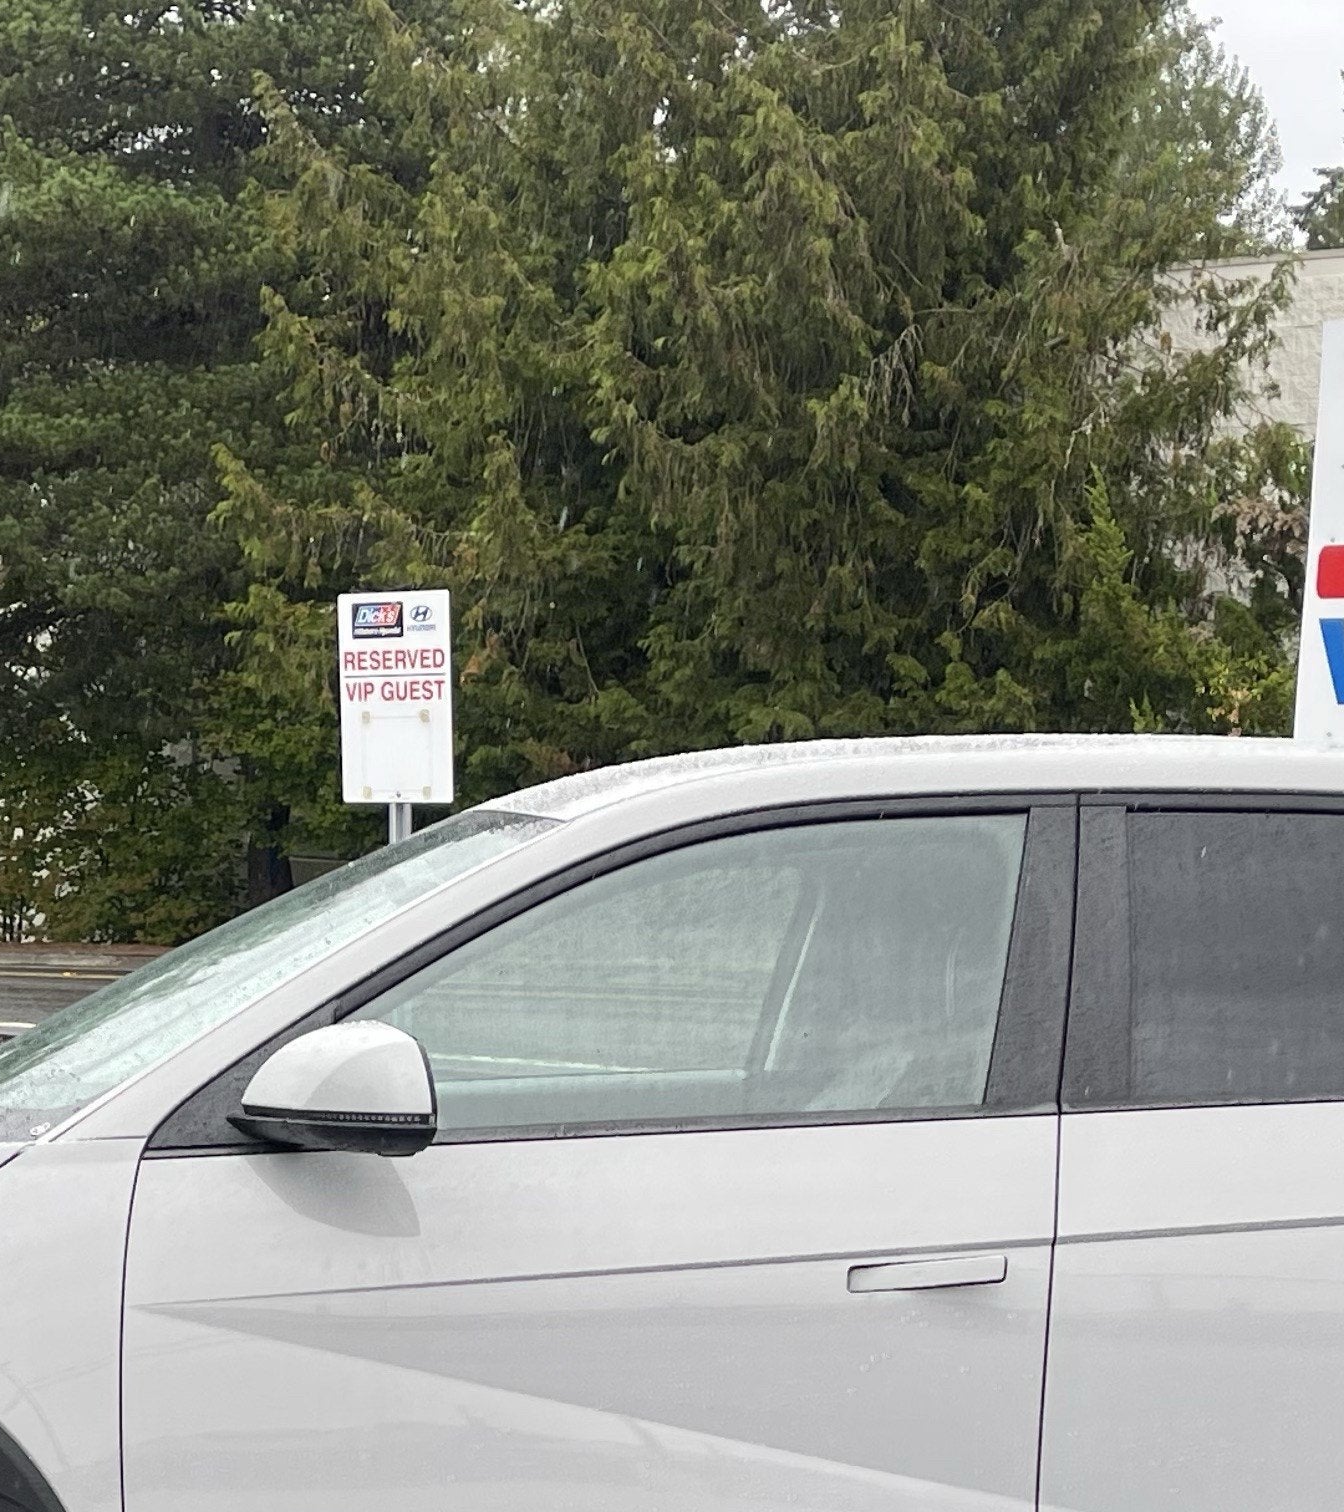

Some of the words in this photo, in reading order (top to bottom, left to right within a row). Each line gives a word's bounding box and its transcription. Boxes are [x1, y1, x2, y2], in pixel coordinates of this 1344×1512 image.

[344, 649, 445, 670] RESERVED
[346, 682, 375, 702] VIP
[381, 680, 446, 701] GUEST
